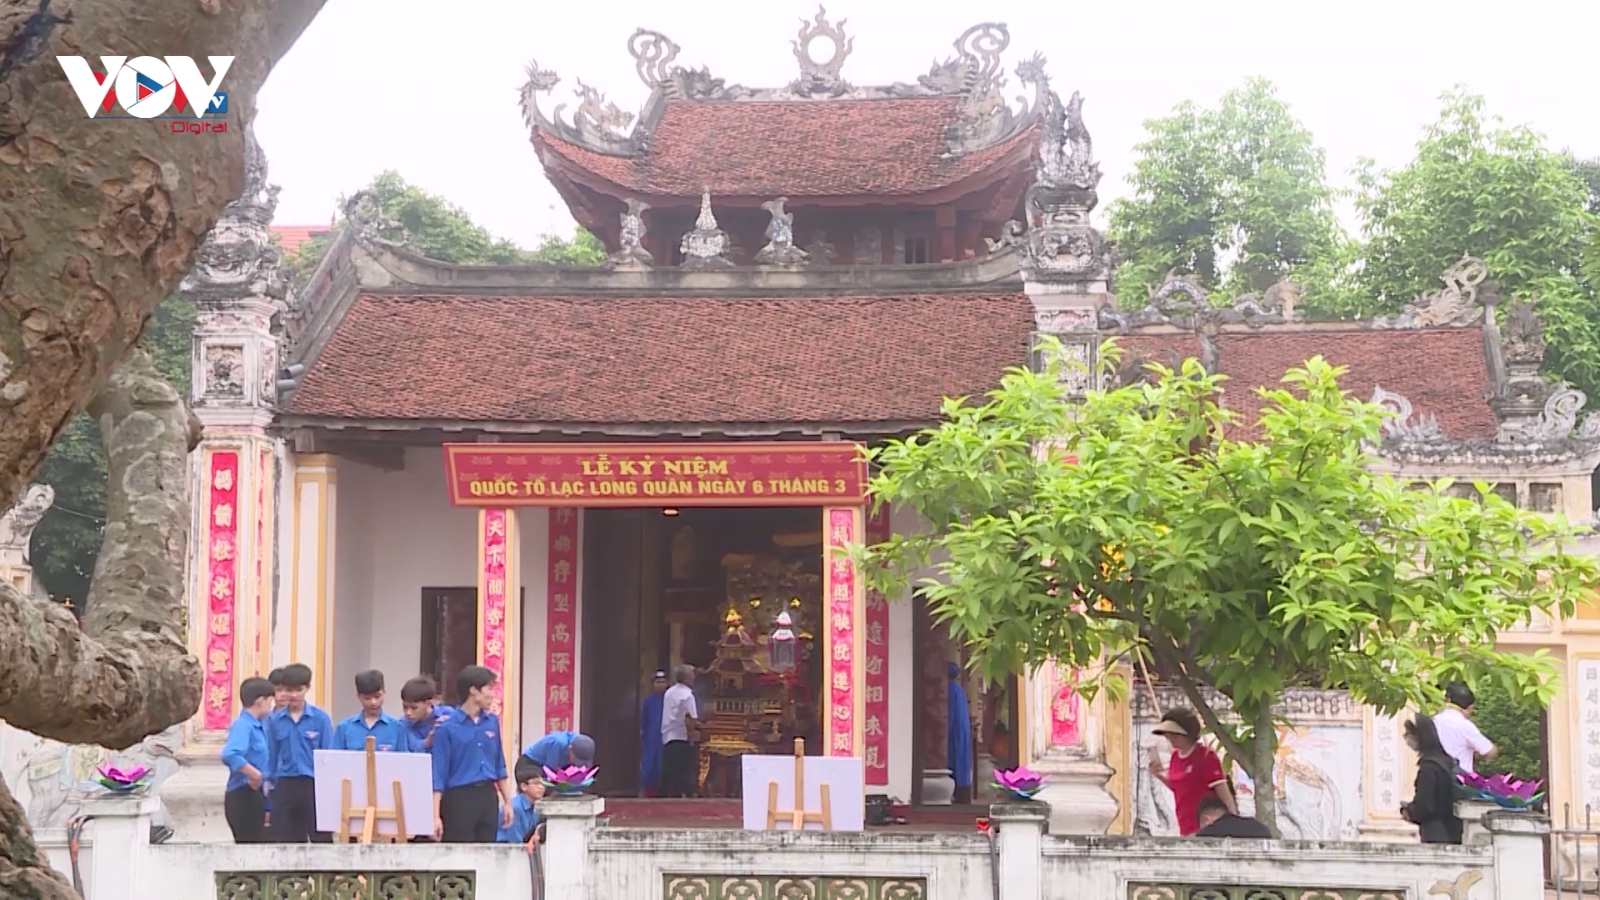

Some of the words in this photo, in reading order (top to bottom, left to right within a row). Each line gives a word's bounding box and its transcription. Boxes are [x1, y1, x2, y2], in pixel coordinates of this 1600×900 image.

[582, 453, 613, 476] LỄ
[663, 456, 729, 479] NIỆM
[470, 475, 518, 497] QUỐC
[551, 480, 585, 498] LẠC
[590, 480, 638, 496] LONG
[643, 477, 693, 496] QUÂN
[699, 477, 747, 495] NGÀY
[752, 479, 764, 494] 6
[769, 477, 829, 494] THÁNG
[835, 479, 847, 494] 3
